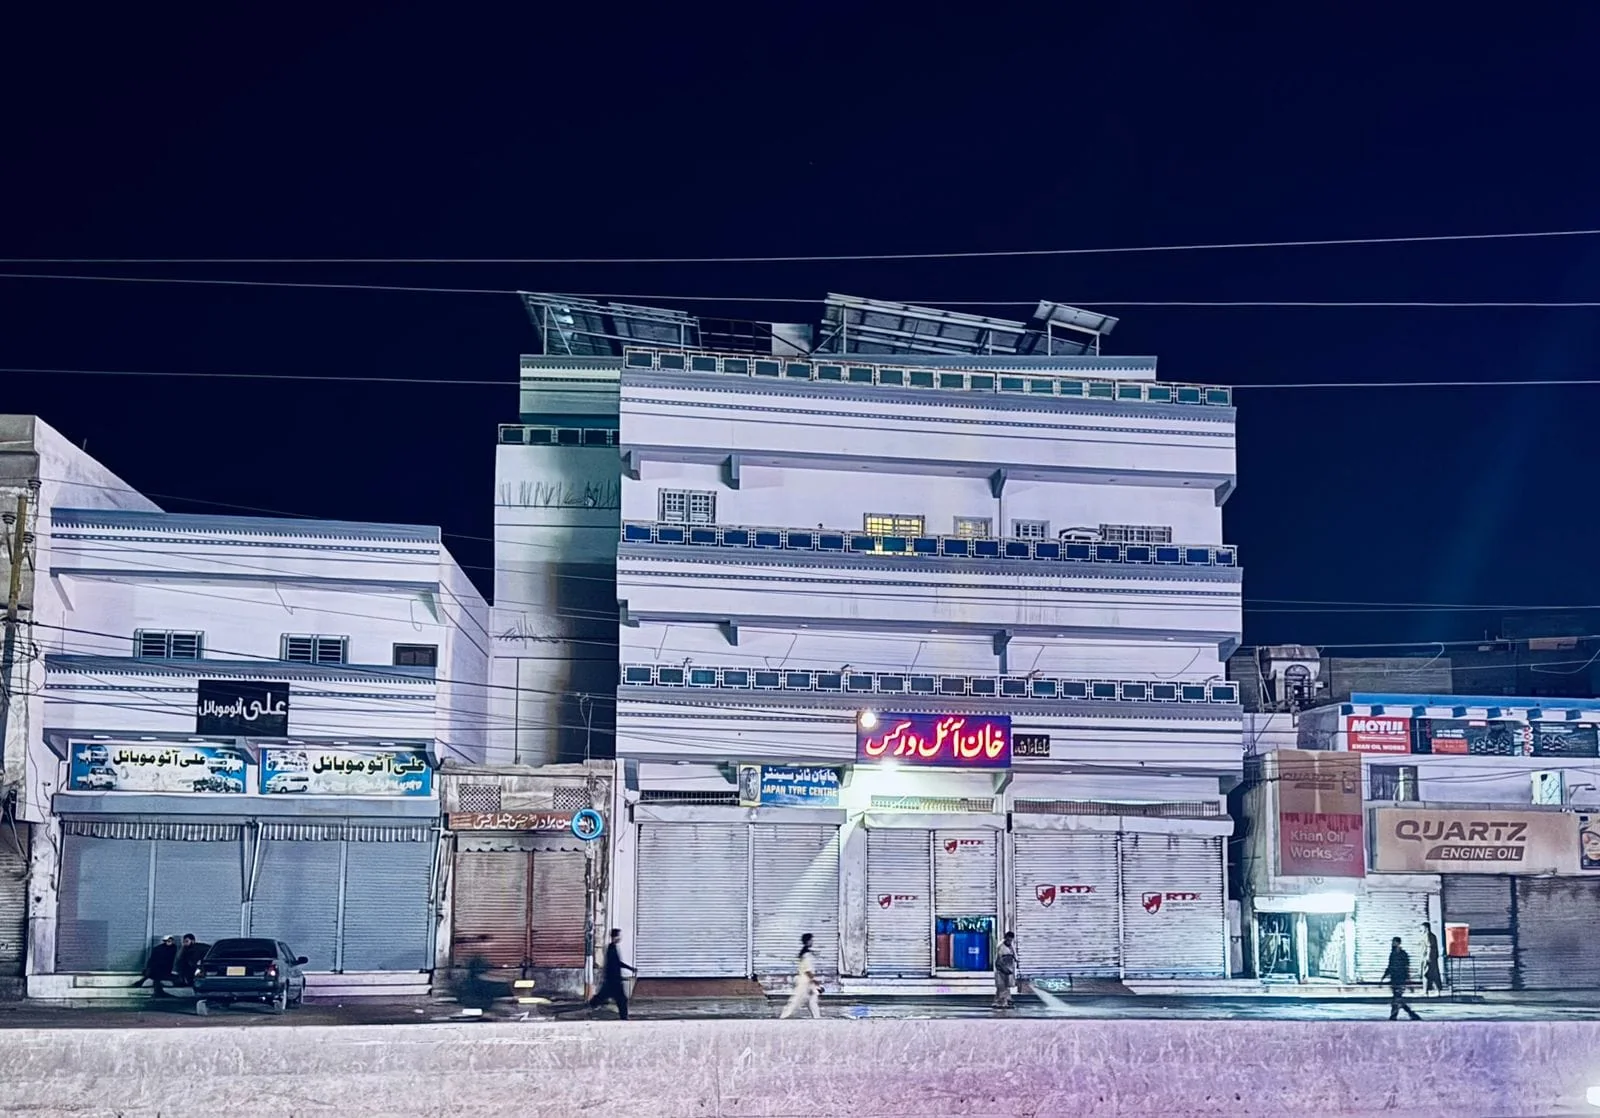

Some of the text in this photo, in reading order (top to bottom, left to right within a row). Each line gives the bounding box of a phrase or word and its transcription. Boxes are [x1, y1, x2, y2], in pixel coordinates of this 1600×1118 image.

[243, 692, 287, 721] علی
[1351, 719, 1406, 735] MOTUL
[865, 716, 1005, 758] خان آئل ورکس
[180, 753, 206, 767] علی
[393, 756, 425, 775] علی
[762, 784, 838, 797] JAPAN TYRE CENTRE
[1290, 830, 1344, 843] Khan Oil
[1395, 819, 1528, 842] QUARTZ
[1290, 845, 1333, 859] Works
[1440, 847, 1520, 860] ENGINE OIL
[1060, 885, 1096, 894] RTX
[1166, 892, 1202, 901] RTX
